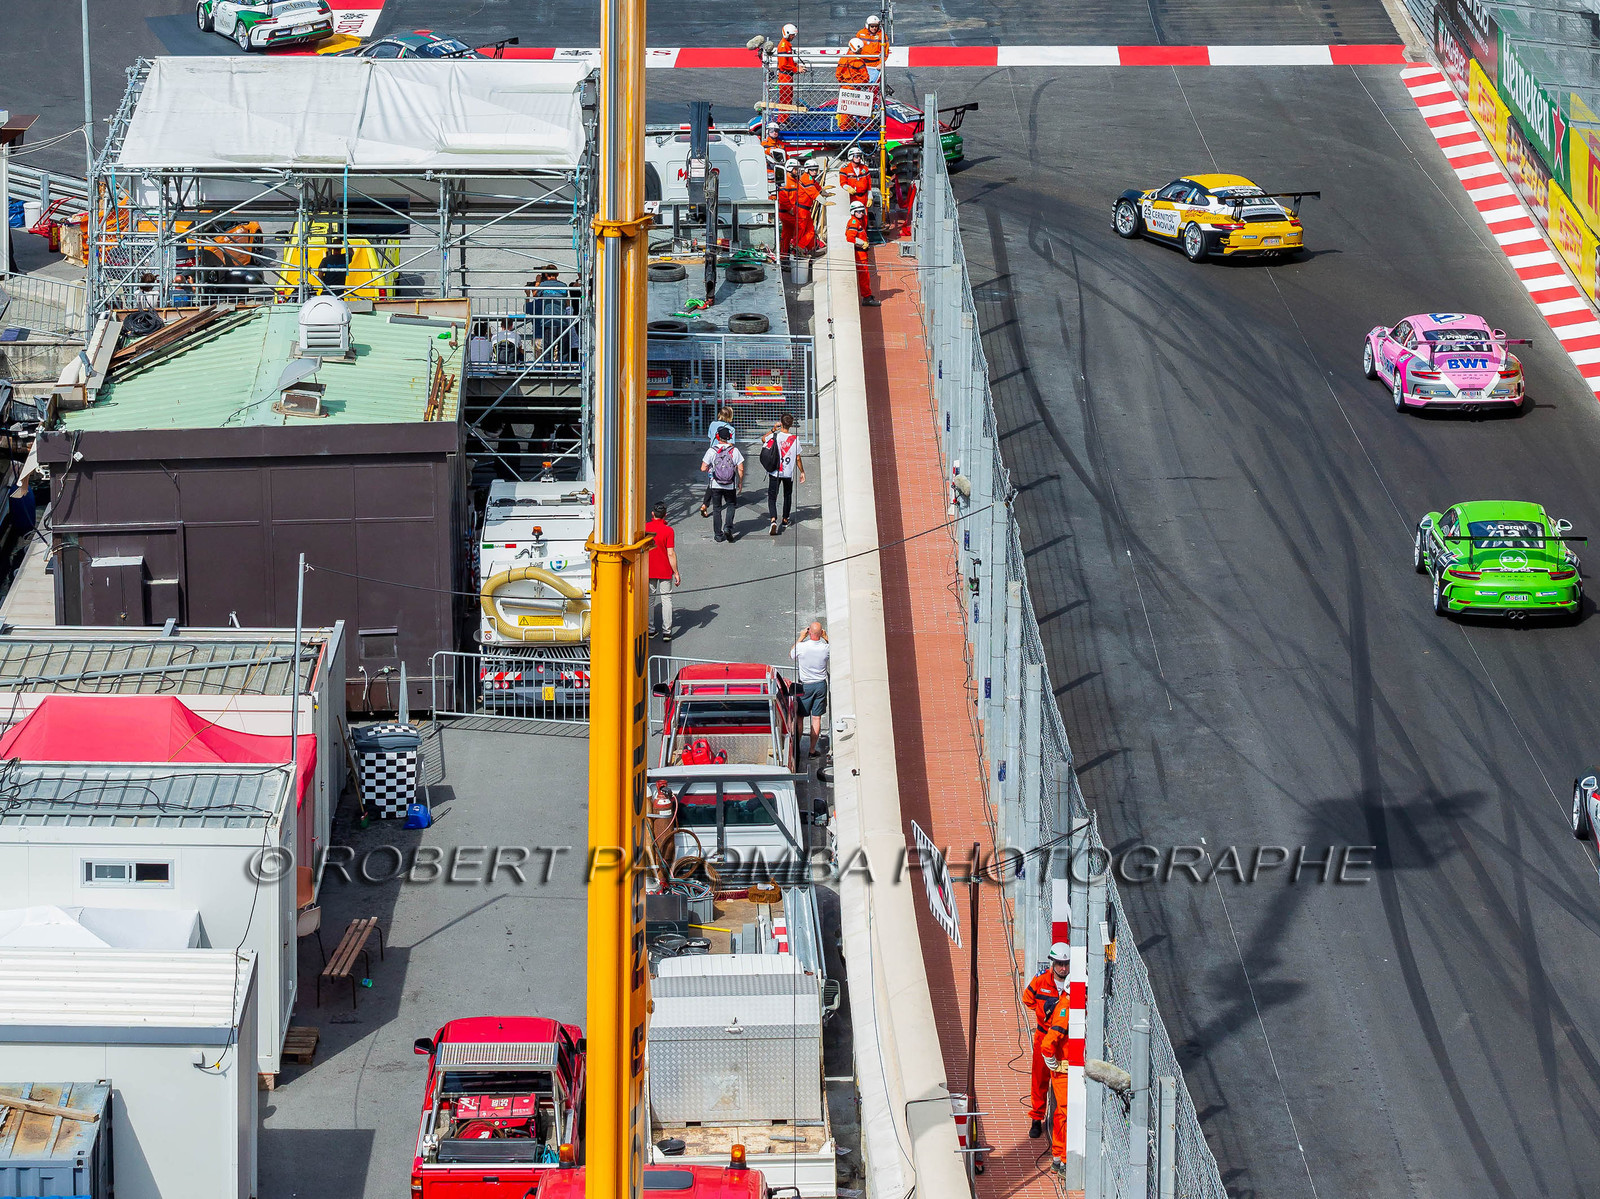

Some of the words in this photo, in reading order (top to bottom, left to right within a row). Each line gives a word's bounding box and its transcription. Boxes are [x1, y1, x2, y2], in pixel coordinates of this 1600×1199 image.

[335, 19, 364, 34] UBS
[1502, 33, 1550, 152] Heineken
[1143, 204, 1152, 216] 25
[1156, 220, 1175, 232] NOVUM
[1447, 358, 1489, 370] BWT
[1497, 524, 1528, 532] Cerqui
